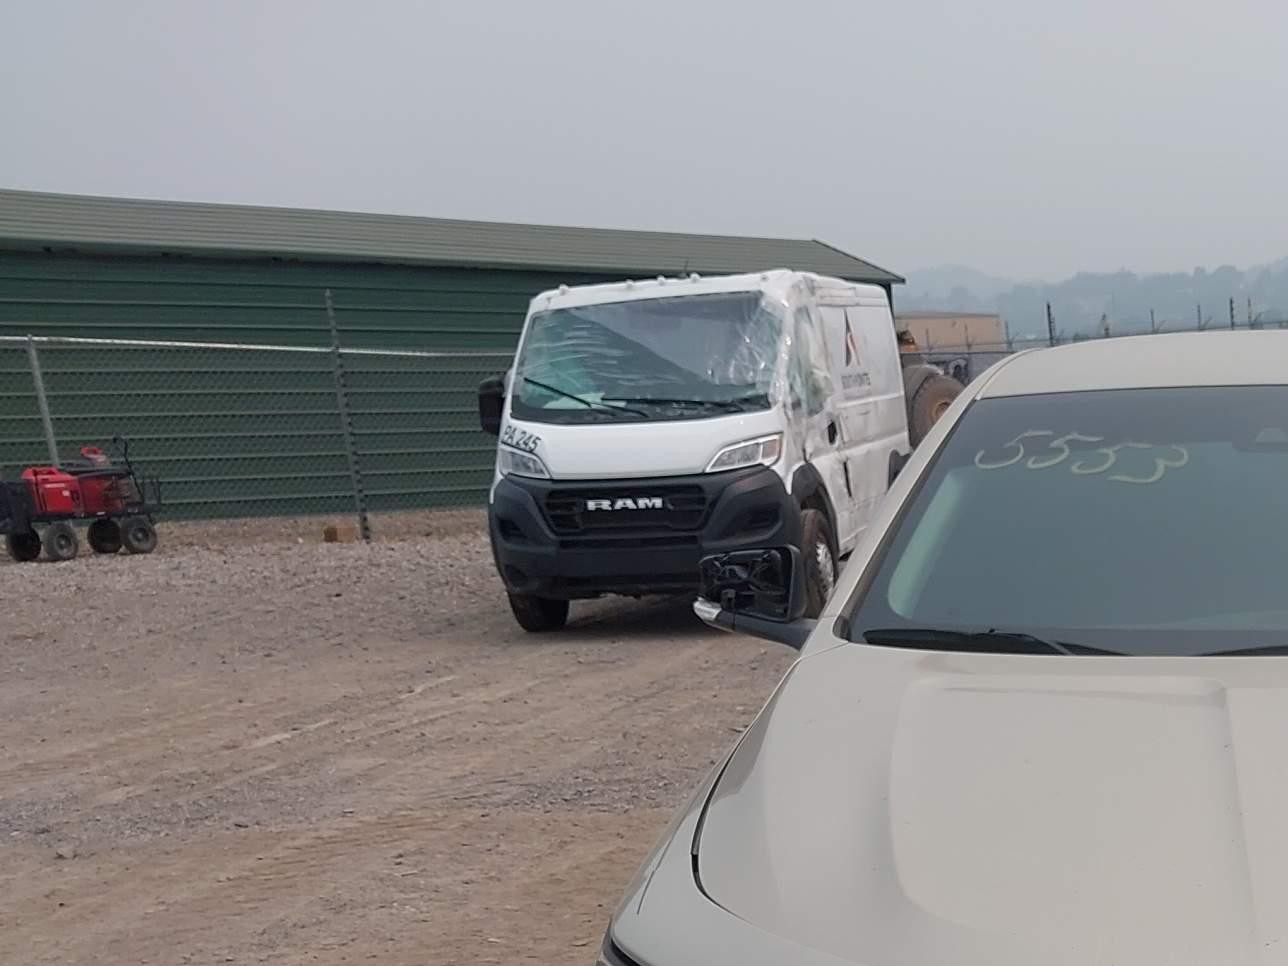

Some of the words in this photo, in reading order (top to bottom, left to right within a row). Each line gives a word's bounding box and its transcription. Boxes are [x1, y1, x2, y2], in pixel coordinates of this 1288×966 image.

[515, 430, 542, 452] 245
[974, 429, 1189, 484] 5553
[587, 497, 663, 511] RAM
